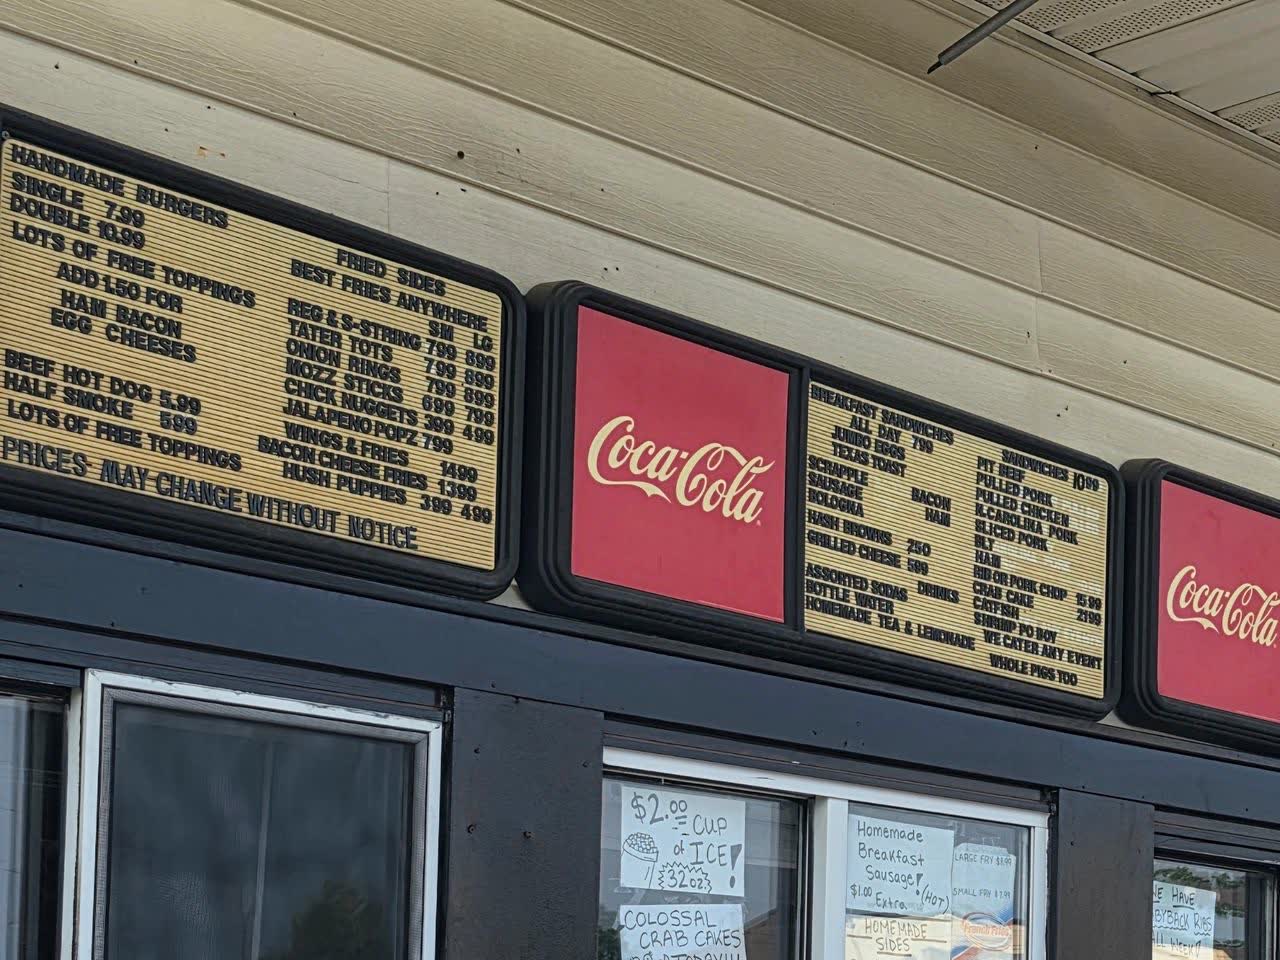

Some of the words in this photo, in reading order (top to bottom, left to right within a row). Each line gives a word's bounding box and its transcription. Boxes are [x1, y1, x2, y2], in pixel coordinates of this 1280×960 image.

[12, 145, 124, 196] HANDMADE
[137, 186, 229, 228] BURGERS
[12, 173, 84, 209] SINGLE
[104, 201, 145, 228] 7.99
[336, 249, 387, 278] FRIED
[397, 269, 446, 296] SIDES
[291, 261, 335, 286] BEST
[342, 276, 391, 304] FRIES
[397, 292, 488, 333] ANYWHERE
[811, 384, 878, 419] BREAKFAST
[882, 408, 954, 444] SANDWICHES
[850, 415, 872, 434] ALL
[878, 425, 901, 443] DAY
[912, 436, 933, 453] 799
[587, 415, 775, 525] Coca-Cola
[100, 459, 149, 488] MAY
[156, 471, 242, 513] CHANGE
[247, 494, 340, 533] WITHOUT
[348, 516, 418, 549] NOTICE
[976, 473, 1017, 496] PULLED
[1022, 487, 1054, 507] PORK
[692, 815, 727, 836] CUP
[857, 821, 923, 843] Homemade
[674, 841, 685, 855] of
[690, 842, 742, 888] ICE!
[859, 843, 925, 867] Breakfast
[866, 866, 923, 896] Sausage!
[624, 910, 717, 930] COLOSSAL
[865, 919, 927, 938] HOMEMADE
[640, 929, 689, 949] CRAB
[695, 930, 741, 948] CAKES
[876, 938, 910, 952] SIDES
